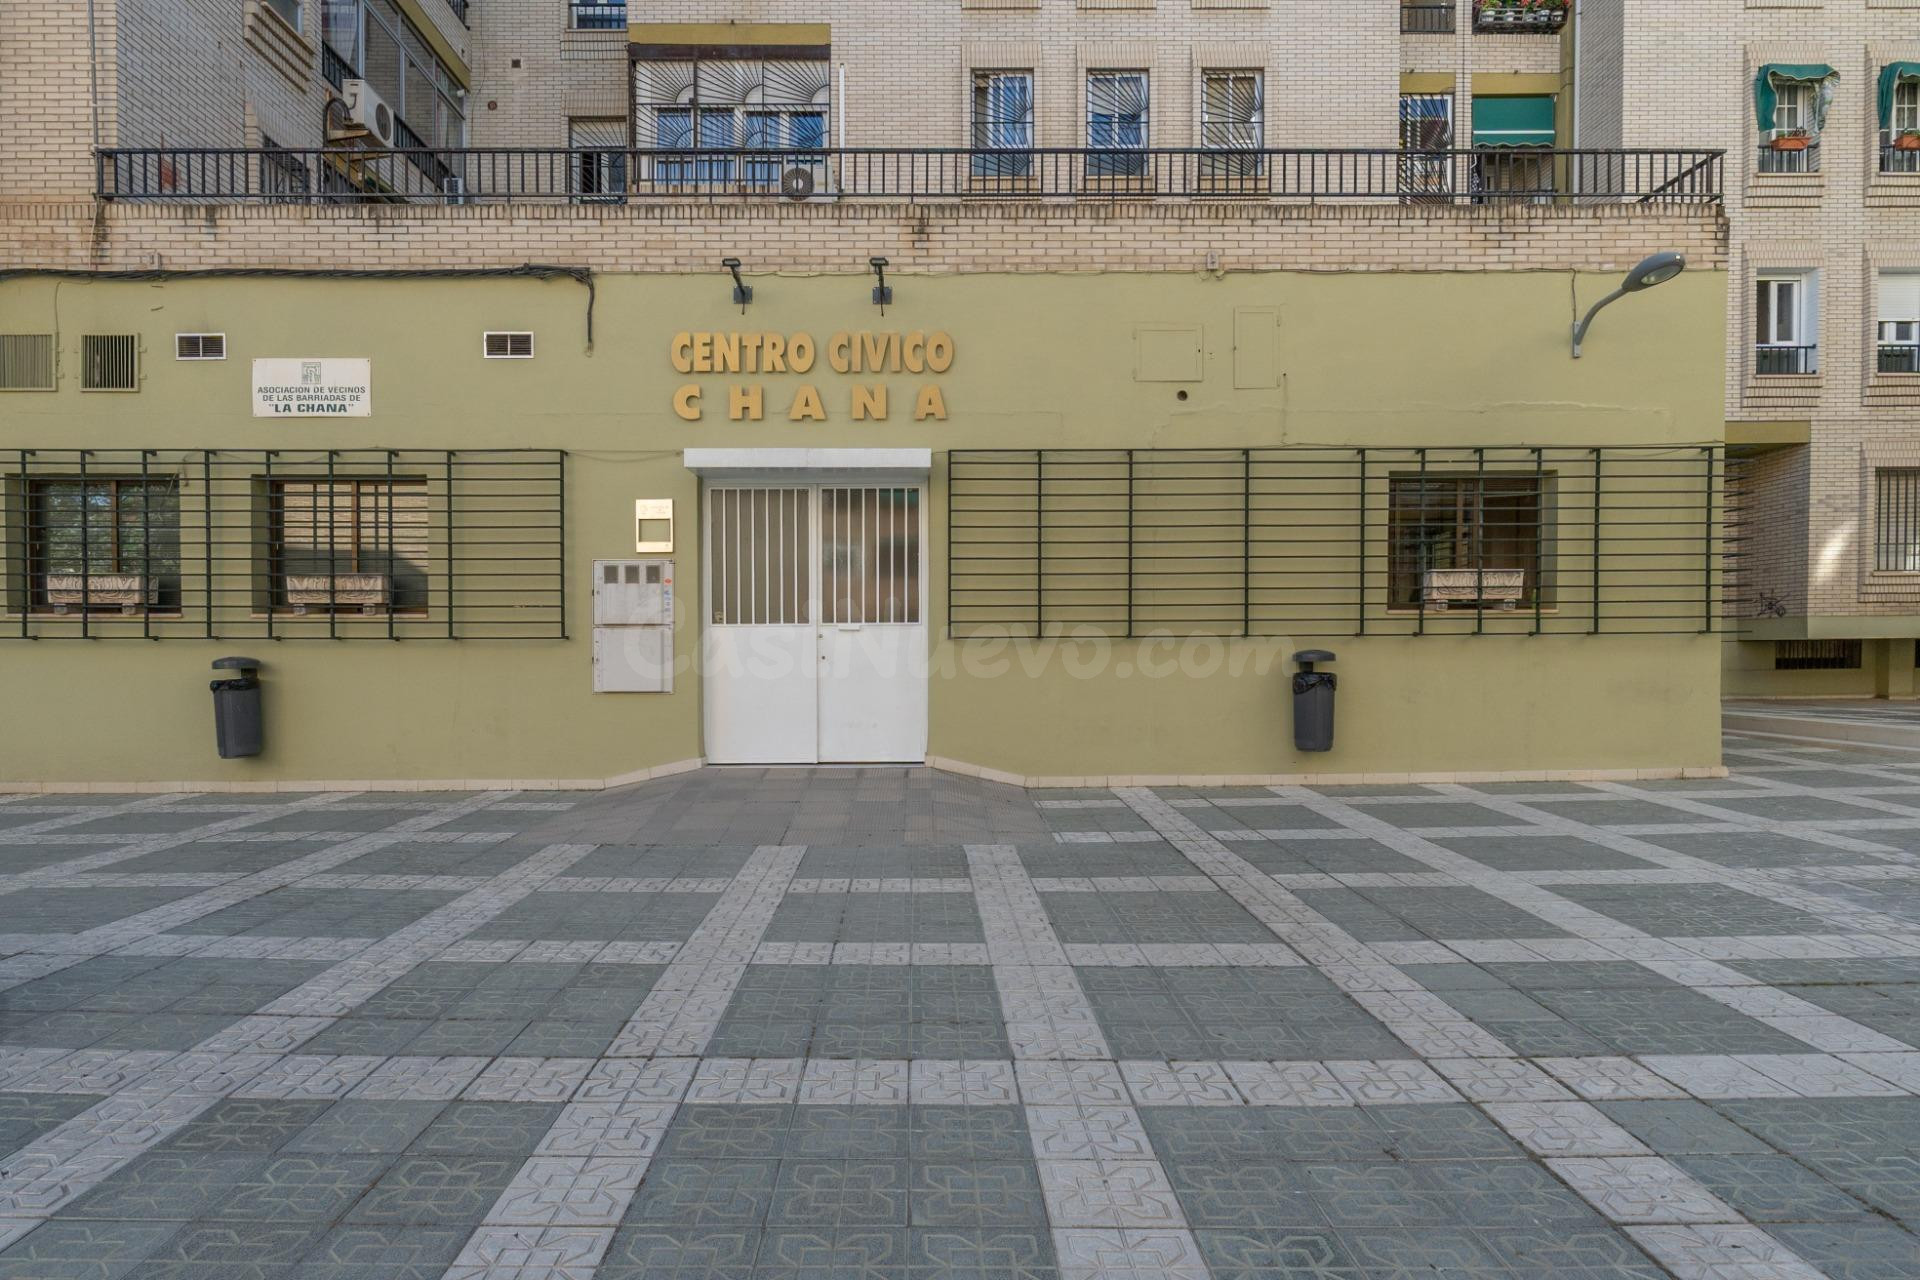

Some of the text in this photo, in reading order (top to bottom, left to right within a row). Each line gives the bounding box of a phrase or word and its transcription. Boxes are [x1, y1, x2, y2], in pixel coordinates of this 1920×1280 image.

[670, 331, 955, 373] CENTRO CIVICO
[257, 386, 366, 394] ASOCIACION DE VECINOS
[262, 394, 361, 402] DE LAS BARRIADAS DE
[672, 383, 948, 420] CHANA
